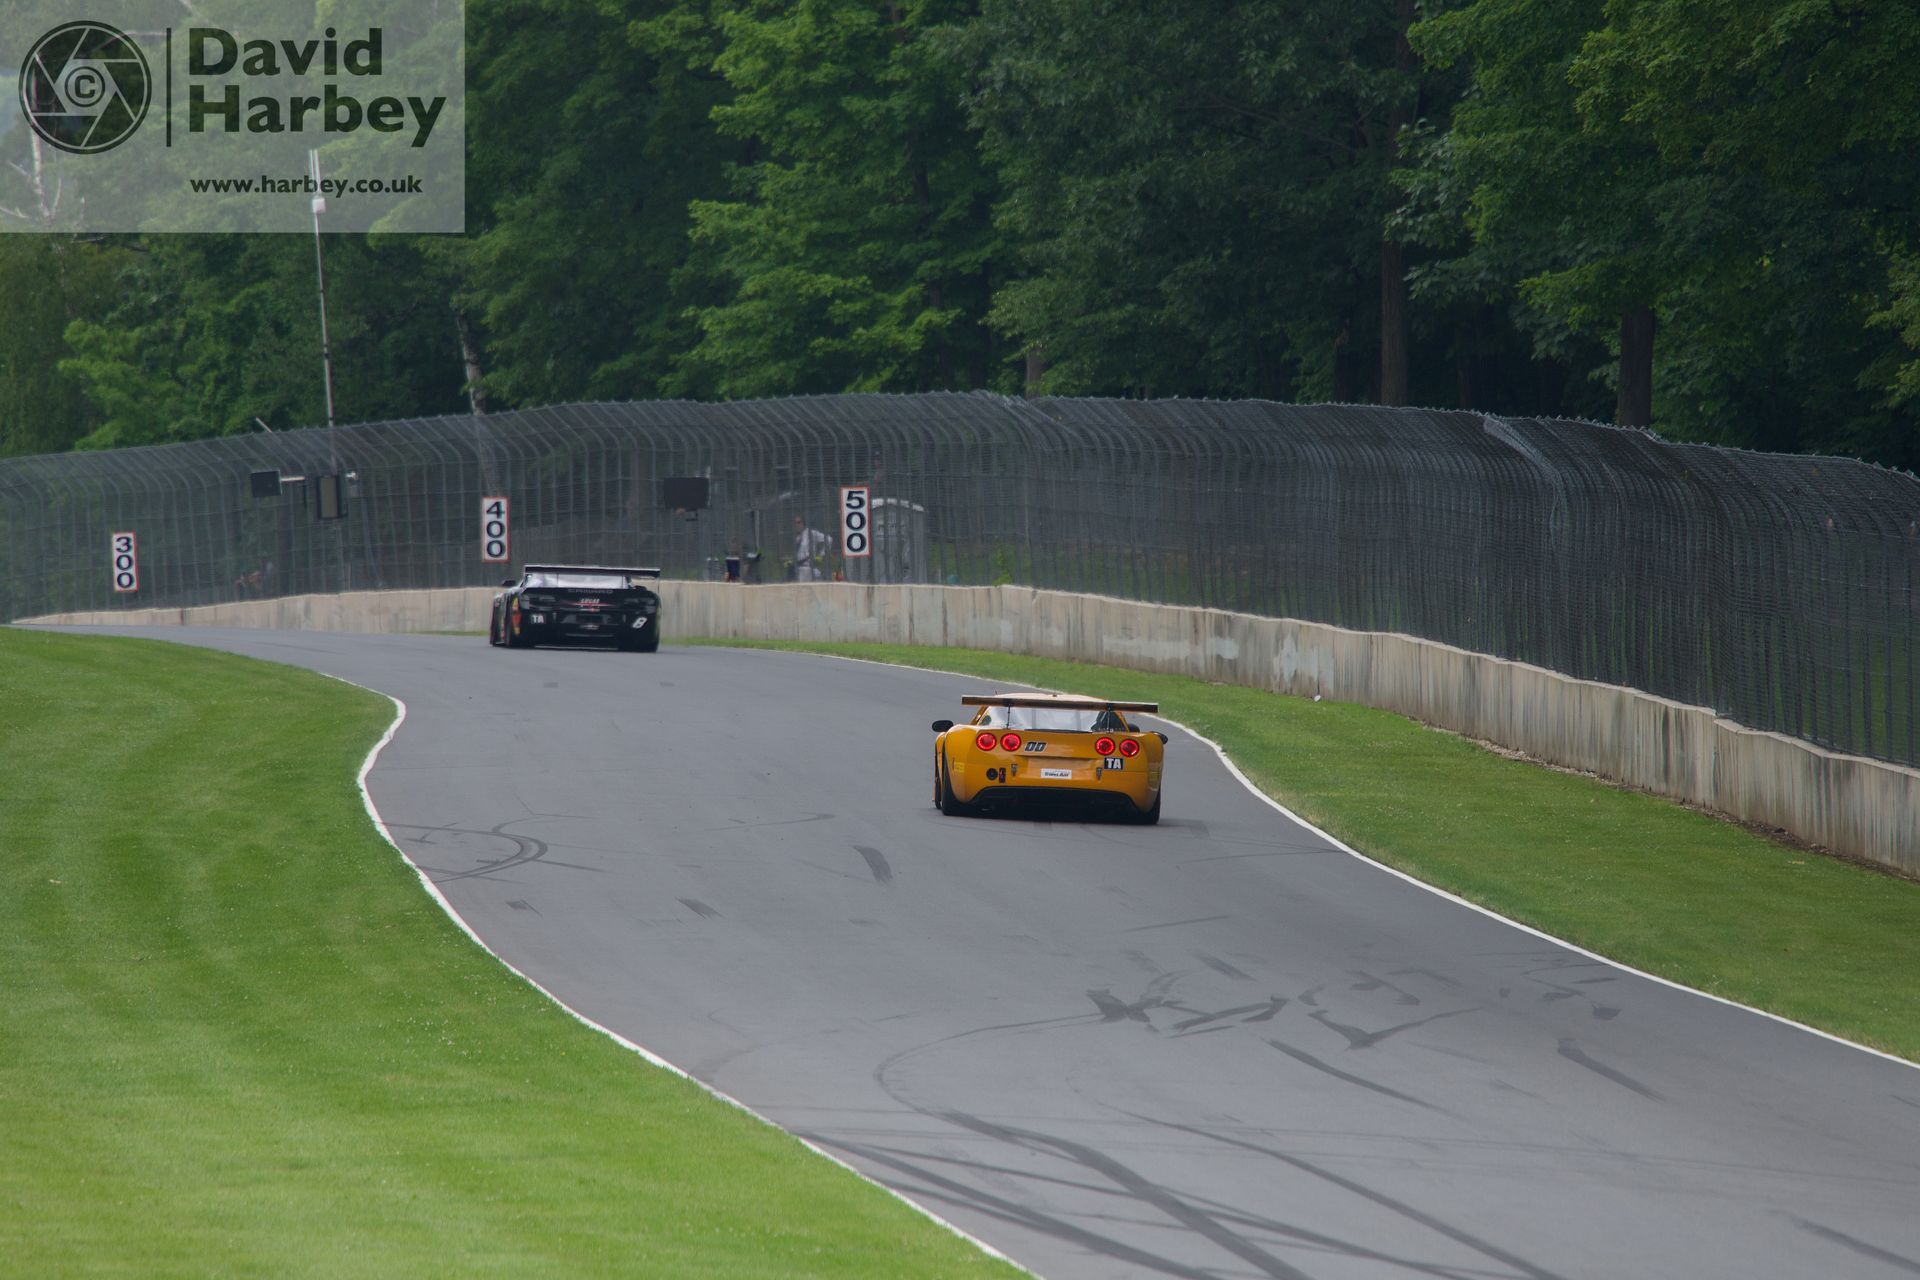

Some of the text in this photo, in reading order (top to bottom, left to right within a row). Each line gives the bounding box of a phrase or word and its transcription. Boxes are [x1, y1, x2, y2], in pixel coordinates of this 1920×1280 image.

[486, 500, 506, 559] 400
[845, 490, 867, 552] 500
[116, 536, 134, 589] 300
[533, 614, 544, 623] TA
[632, 617, 647, 629] 8
[1106, 758, 1122, 769] TA
